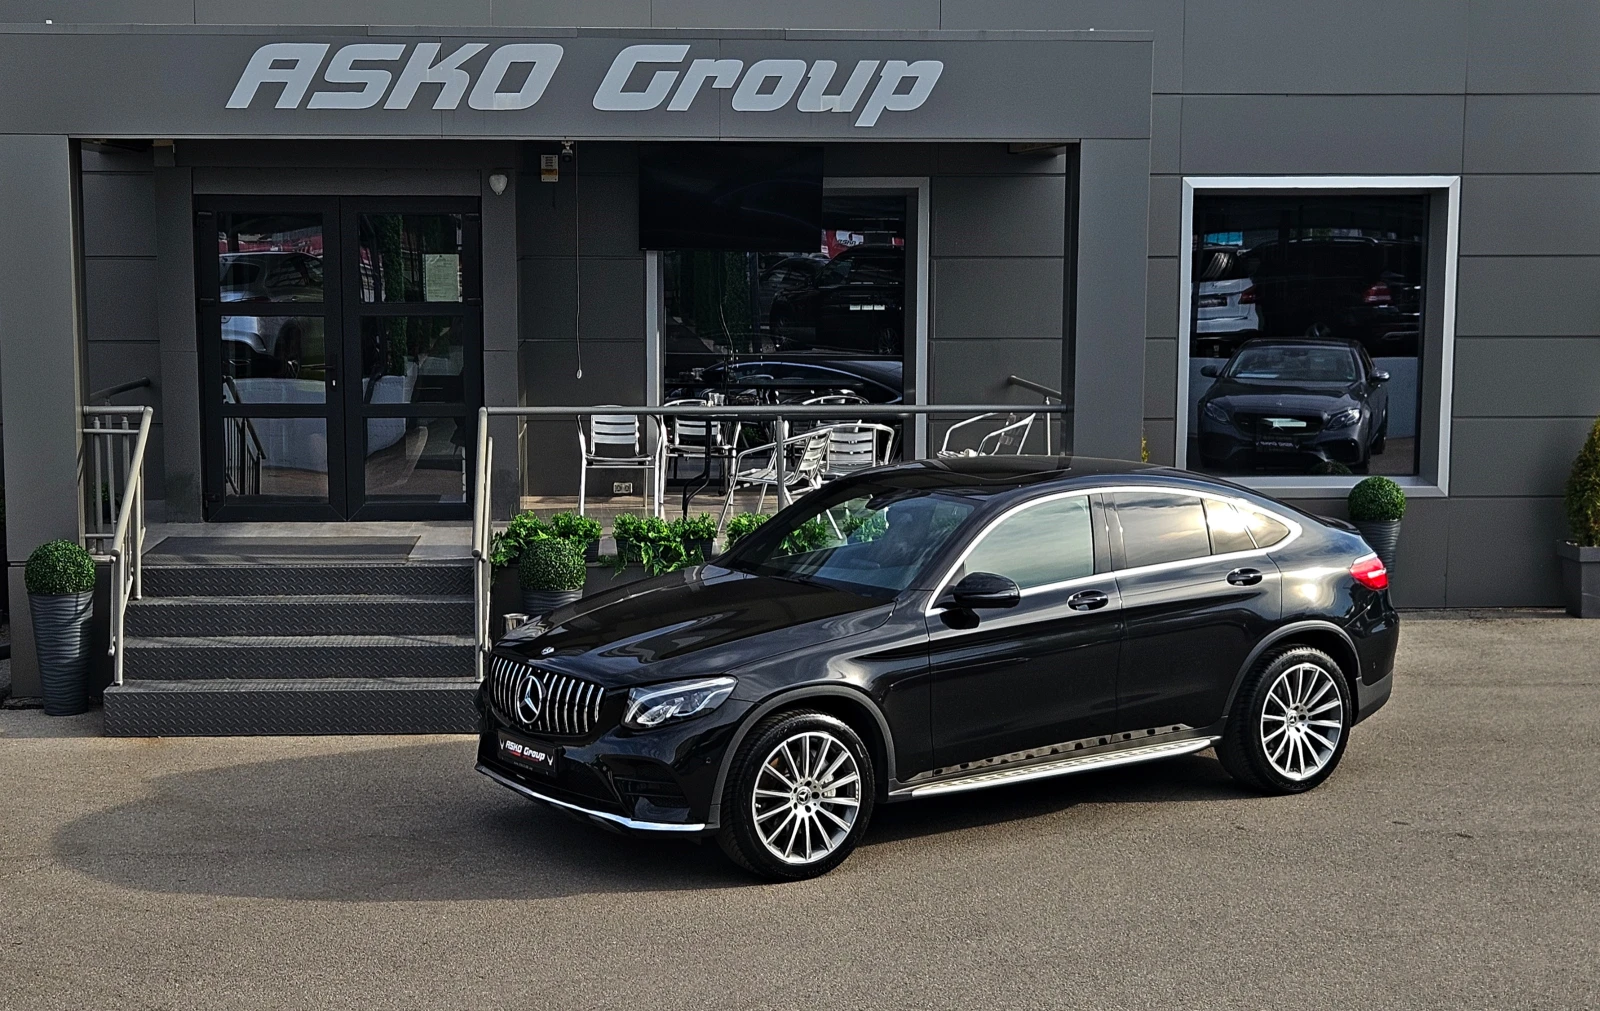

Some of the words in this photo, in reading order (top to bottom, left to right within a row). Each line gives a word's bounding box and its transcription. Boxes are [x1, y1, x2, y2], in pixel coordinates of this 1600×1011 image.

[225, 43, 564, 110] ASKO
[592, 44, 944, 127] Group
[505, 740, 523, 754] ASKO
[523, 746, 546, 761] Group
